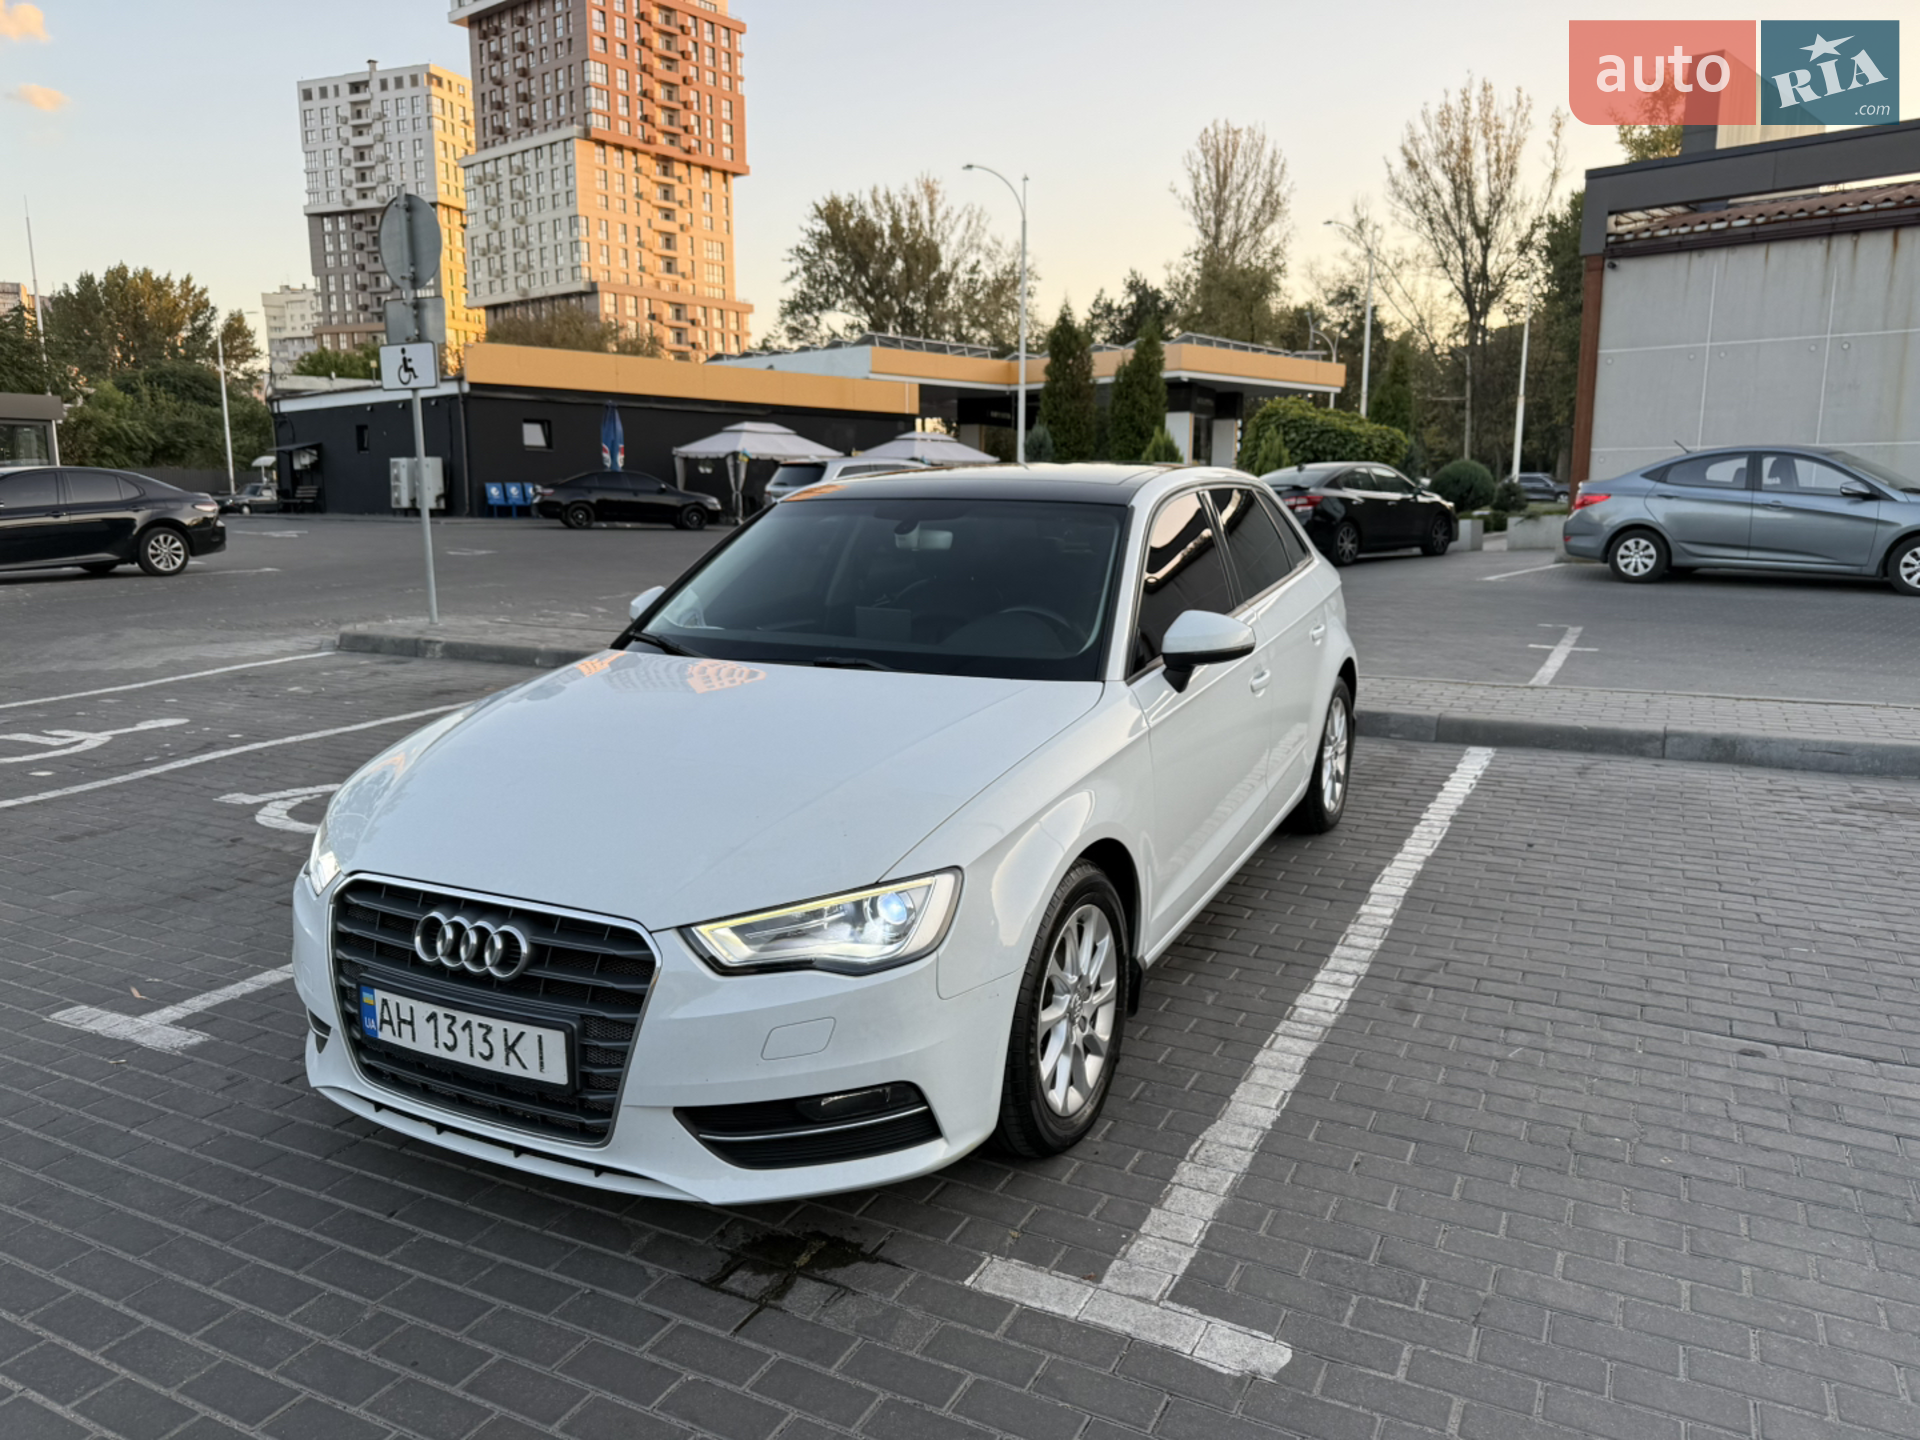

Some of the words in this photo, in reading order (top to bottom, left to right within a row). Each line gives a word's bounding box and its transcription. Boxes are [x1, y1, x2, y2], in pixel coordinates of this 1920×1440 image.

[364, 1016, 377, 1031] UA
[379, 997, 416, 1043] AH
[425, 1010, 495, 1062] 1313
